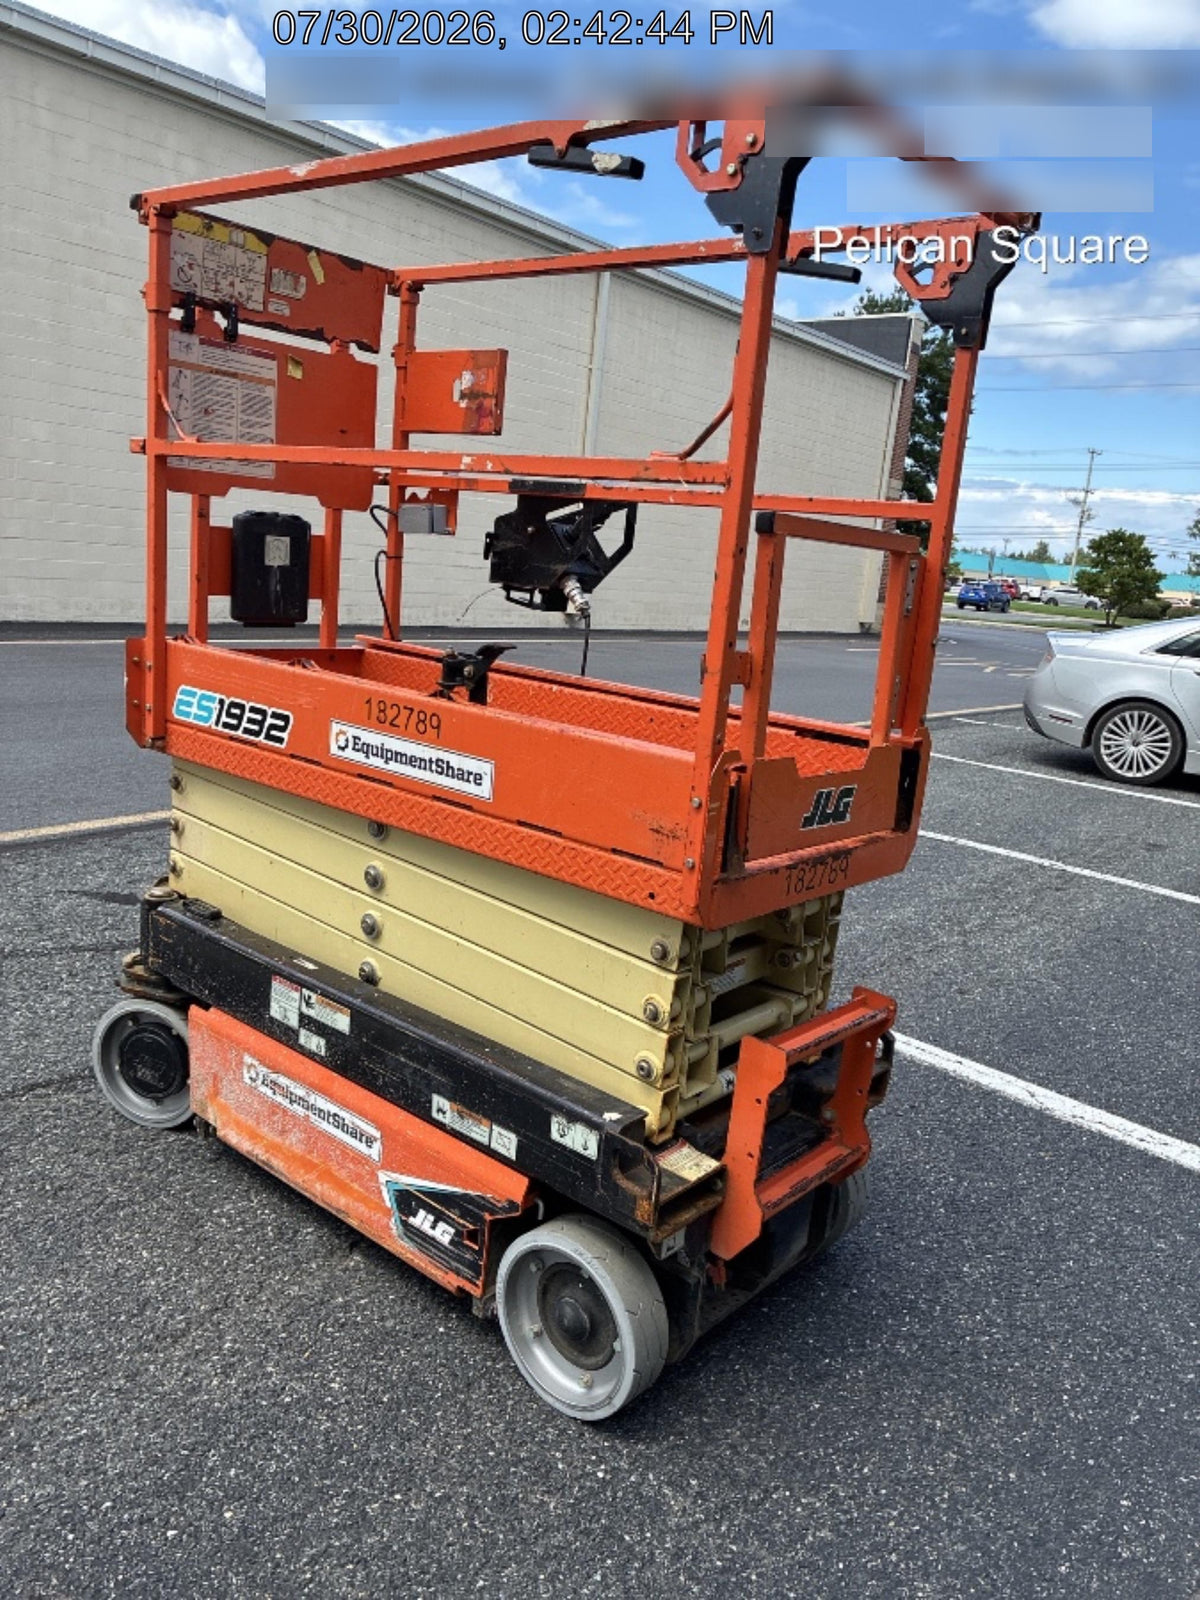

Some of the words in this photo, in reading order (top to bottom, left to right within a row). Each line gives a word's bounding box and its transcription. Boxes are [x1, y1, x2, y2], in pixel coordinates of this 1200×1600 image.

[172, 684, 293, 749] ES1932
[364, 697, 442, 740] 182789
[351, 735, 484, 787] EquipmentShare
[799, 784, 858, 831] JLG
[261, 1072, 376, 1150] EquipmentShare
[408, 1208, 456, 1246] JLG
